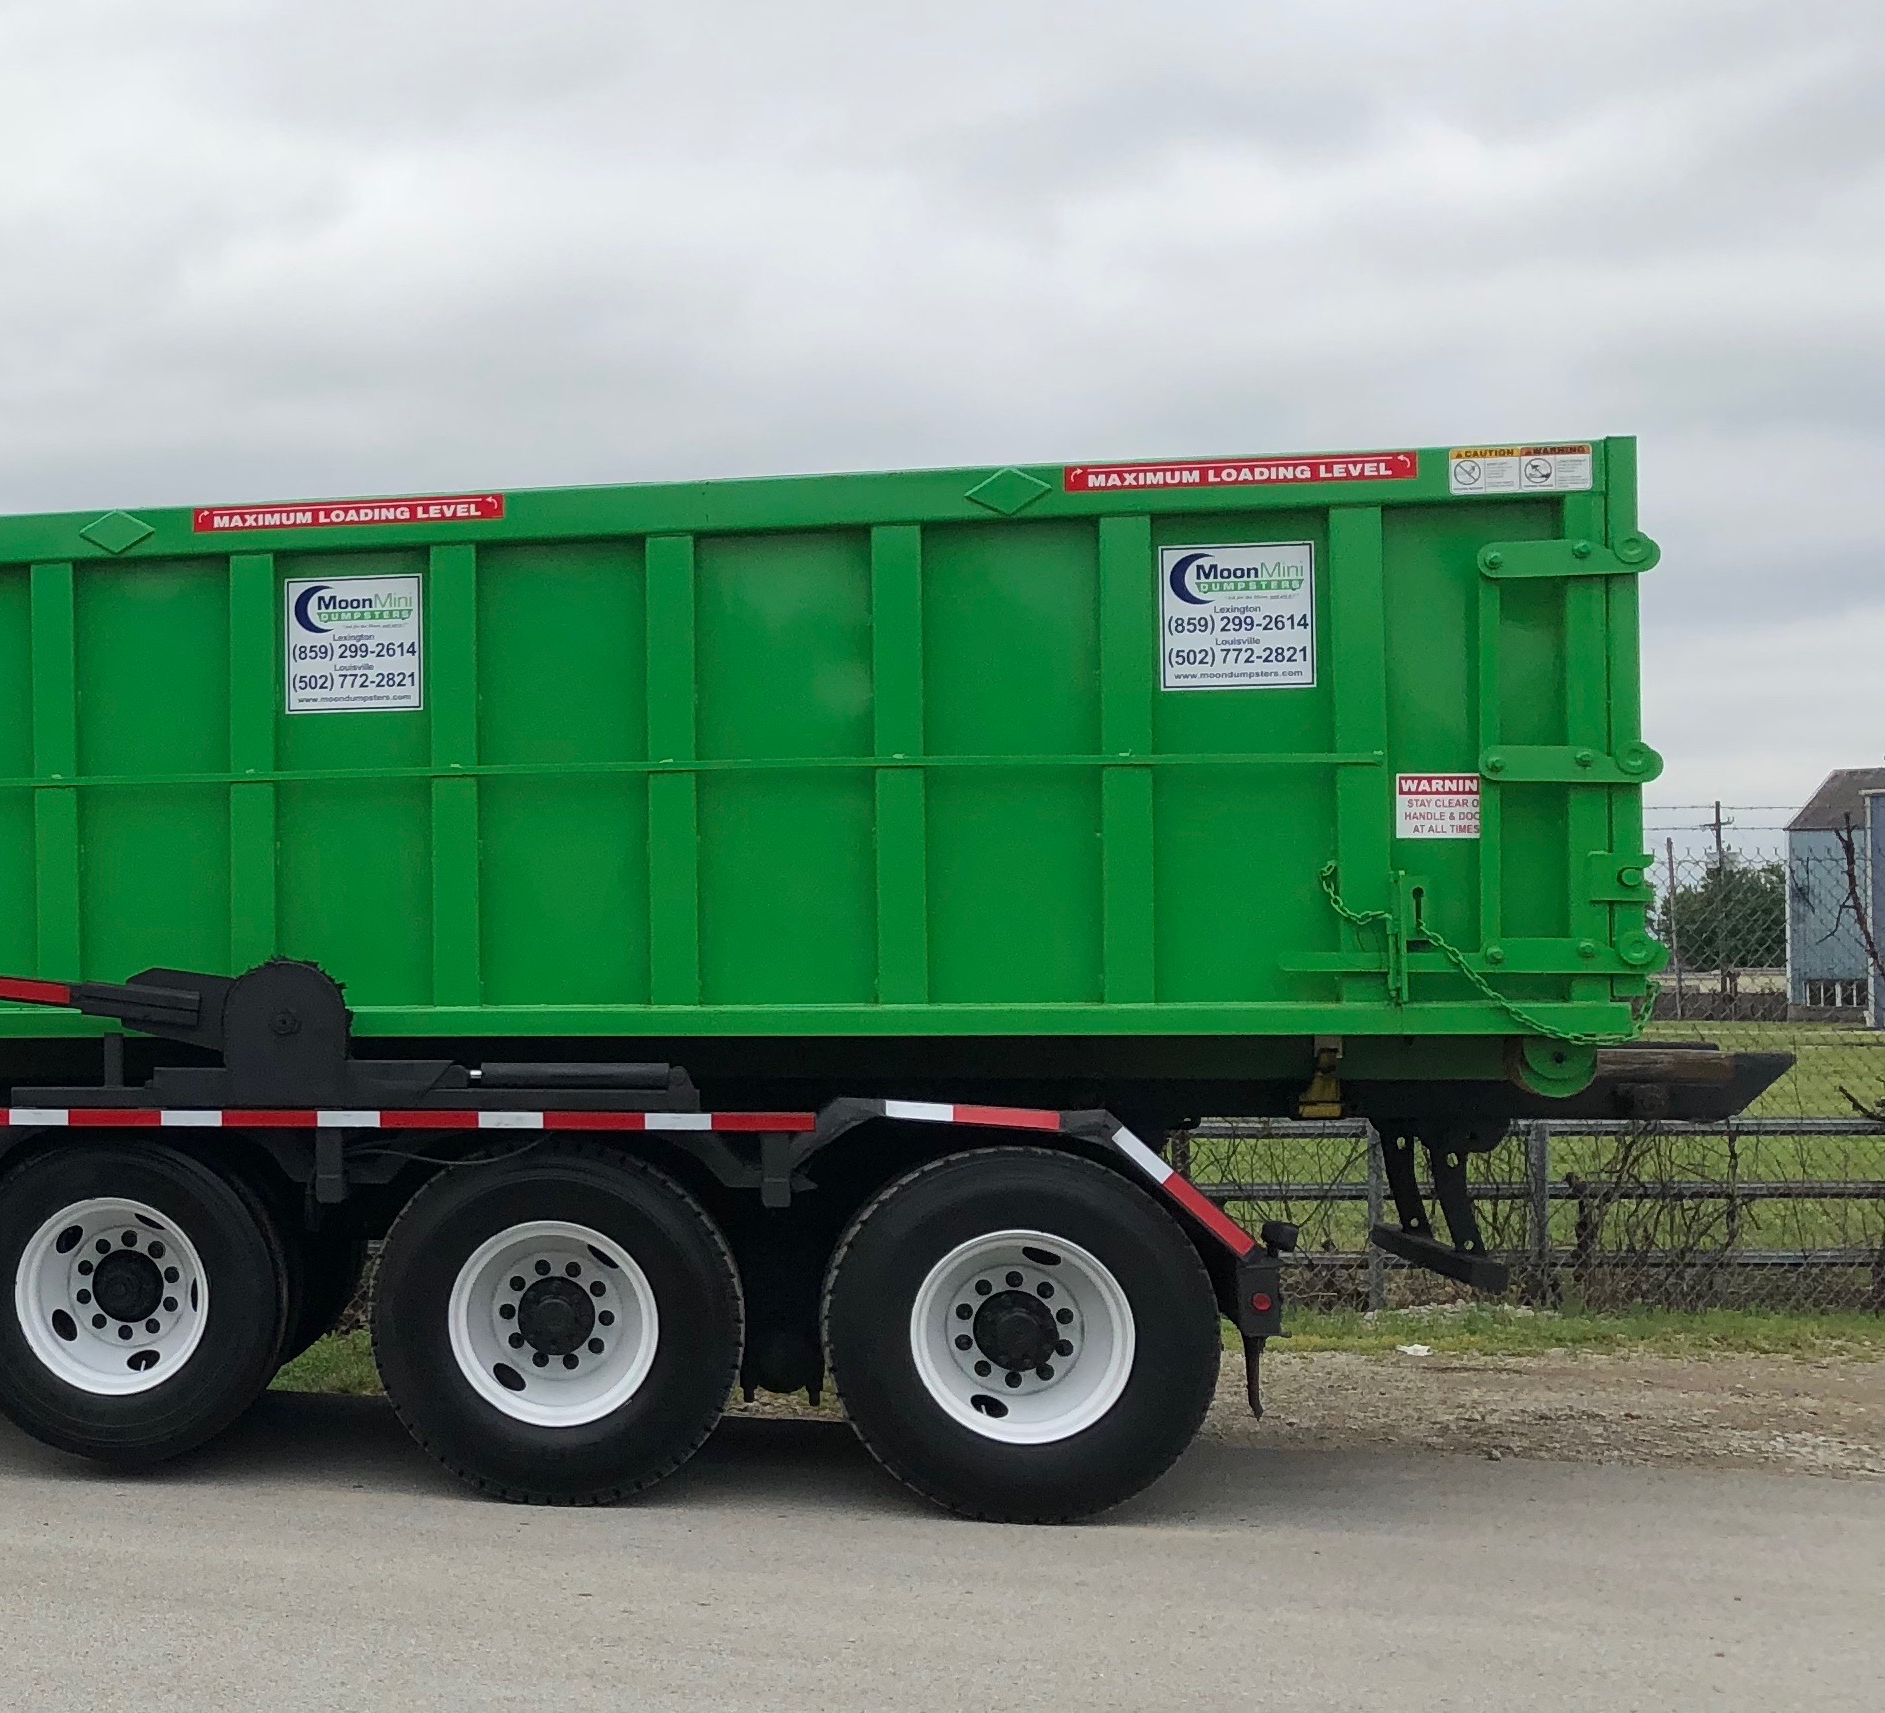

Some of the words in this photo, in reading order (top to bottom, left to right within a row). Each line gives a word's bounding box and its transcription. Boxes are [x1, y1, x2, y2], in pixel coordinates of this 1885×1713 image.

[1464, 449, 1515, 458] CAUTION
[1087, 470, 1200, 487] MAXIMUM
[1208, 466, 1311, 482] LOADING
[1319, 463, 1392, 478] LEVEL
[213, 511, 312, 528] MAXIMUM
[318, 507, 410, 523] LOADING
[417, 504, 481, 519] LEVEL
[1200, 580, 1300, 592] DUMPSTERS
[320, 610, 410, 620] DUMPSTERS
[1213, 605, 1261, 615] Lexington
[1168, 614, 1216, 635] (859)
[1220, 613, 1309, 632] 299-2614
[333, 634, 375, 642] Lexington
[1215, 637, 1261, 646] Louisville
[293, 643, 334, 662] (859)
[338, 641, 417, 659] 299-2614
[1168, 647, 1216, 668] (502)
[1220, 646, 1307, 664] 772-2821
[334, 663, 374, 671] Louisville
[1174, 670, 1303, 679] www.moondumpsters.com
[293, 672, 334, 692] (502)
[338, 672, 415, 688] 772-2821
[298, 694, 411, 703] www.moondumpsters.com
[1400, 779, 1478, 792] WARNIN
[1407, 799, 1433, 808] STAY
[1435, 799, 1469, 808] CLEAR
[1472, 798, 1480, 808] O
[1404, 812, 1446, 821] HANDLE
[1449, 812, 1456, 821] &
[1412, 824, 1425, 834] AT
[1428, 824, 1447, 834] ALL
[1450, 824, 1480, 834] TIMES
